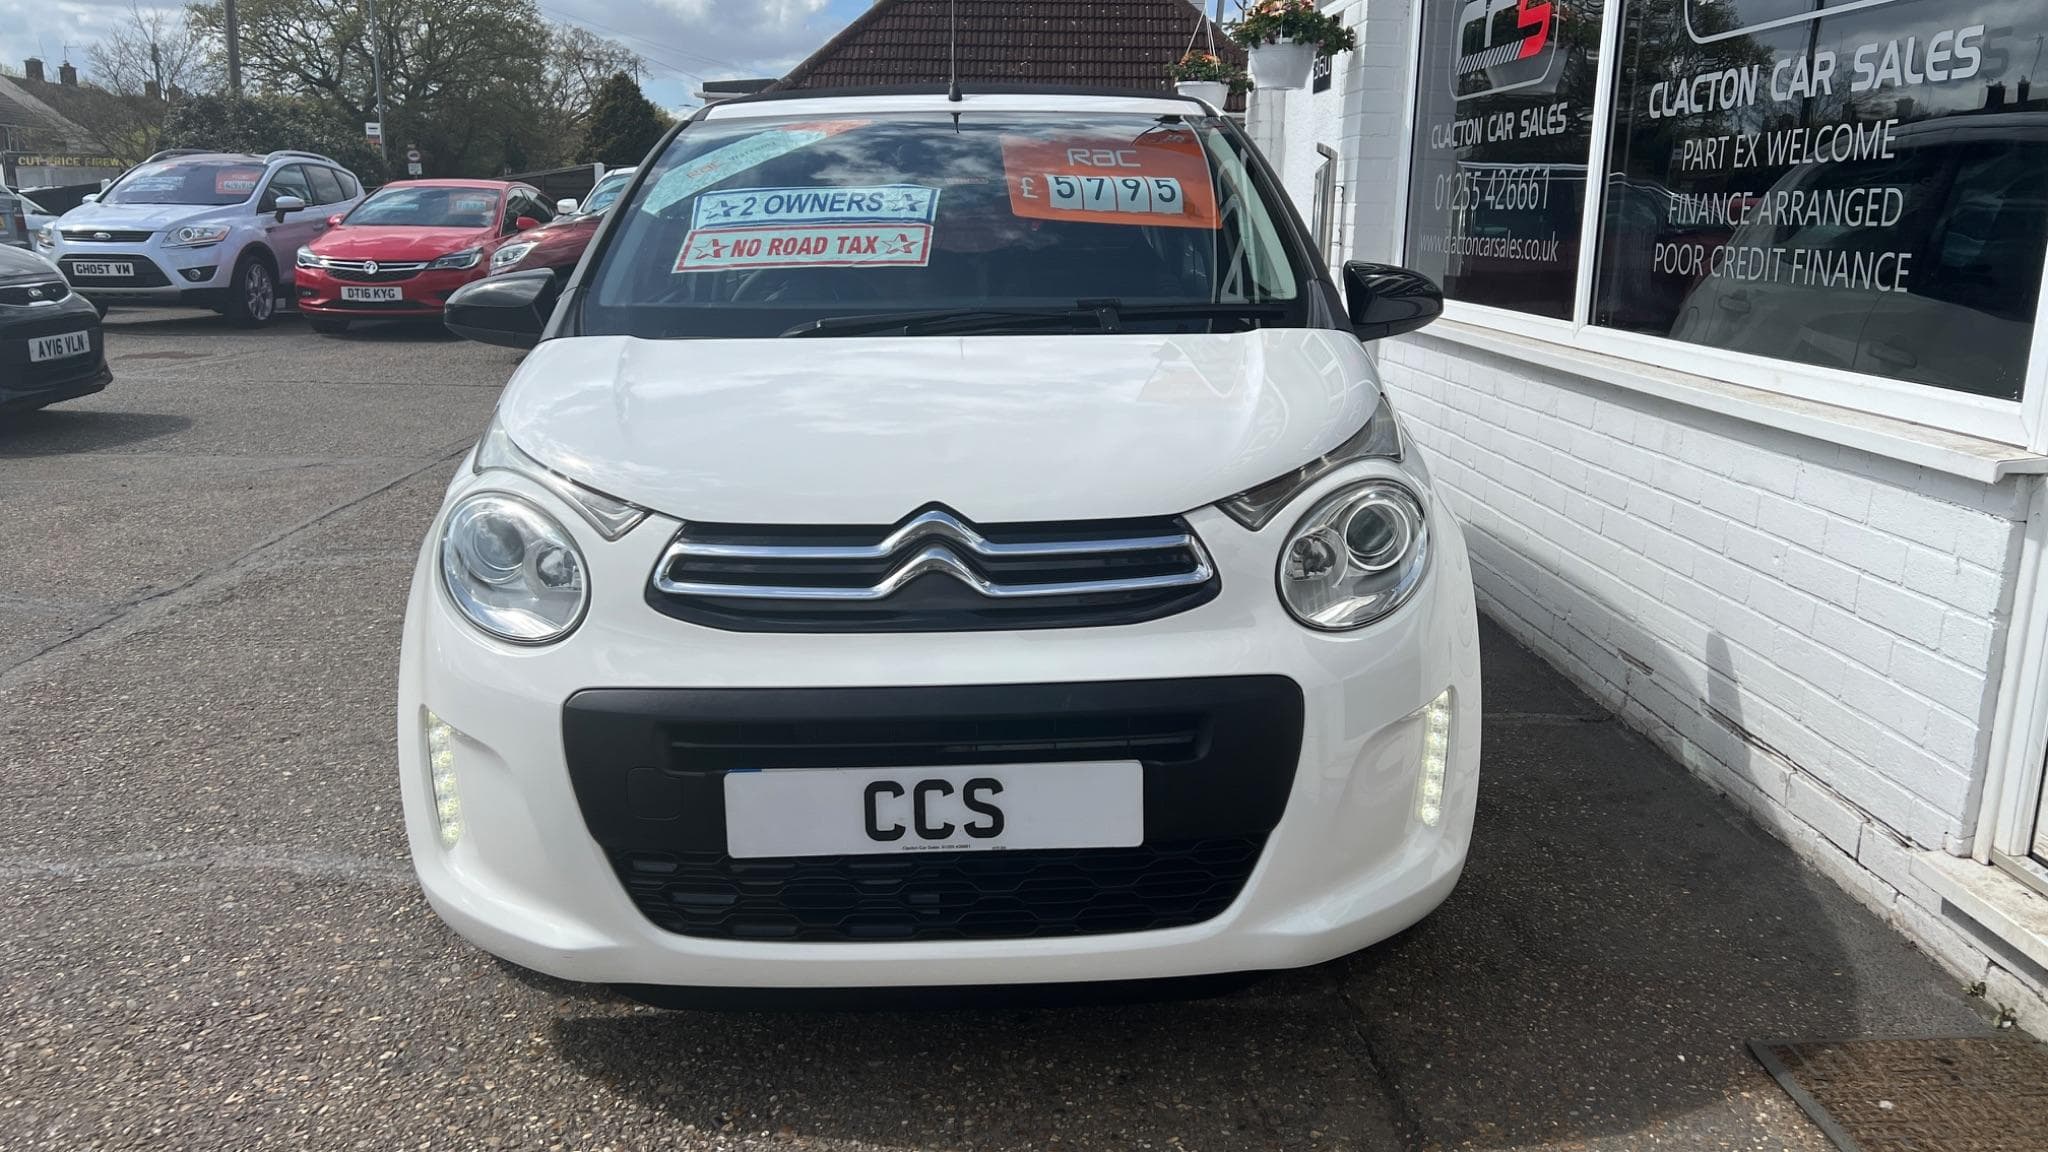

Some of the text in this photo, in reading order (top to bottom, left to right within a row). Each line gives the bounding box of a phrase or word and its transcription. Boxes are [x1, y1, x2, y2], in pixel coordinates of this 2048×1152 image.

[1649, 24, 1985, 119] CLACTON CAR SALES
[1432, 102, 1568, 149] CLACTON CAR SALES
[1682, 119, 1899, 171] PART EX WELCOME
[739, 192, 884, 217] 2 OWNERS
[1434, 166, 1550, 211] 01255 426661
[1668, 188, 1903, 227] FINANCE ARRANGED
[729, 235, 880, 257] NO ROAD TAX
[114, 264, 130, 274] VM
[1653, 242, 1912, 293] POOR CREDIT FINANCE
[374, 288, 395, 298] KYG
[38, 334, 84, 358] AY16 VLN
[864, 777, 1004, 841] CCS
